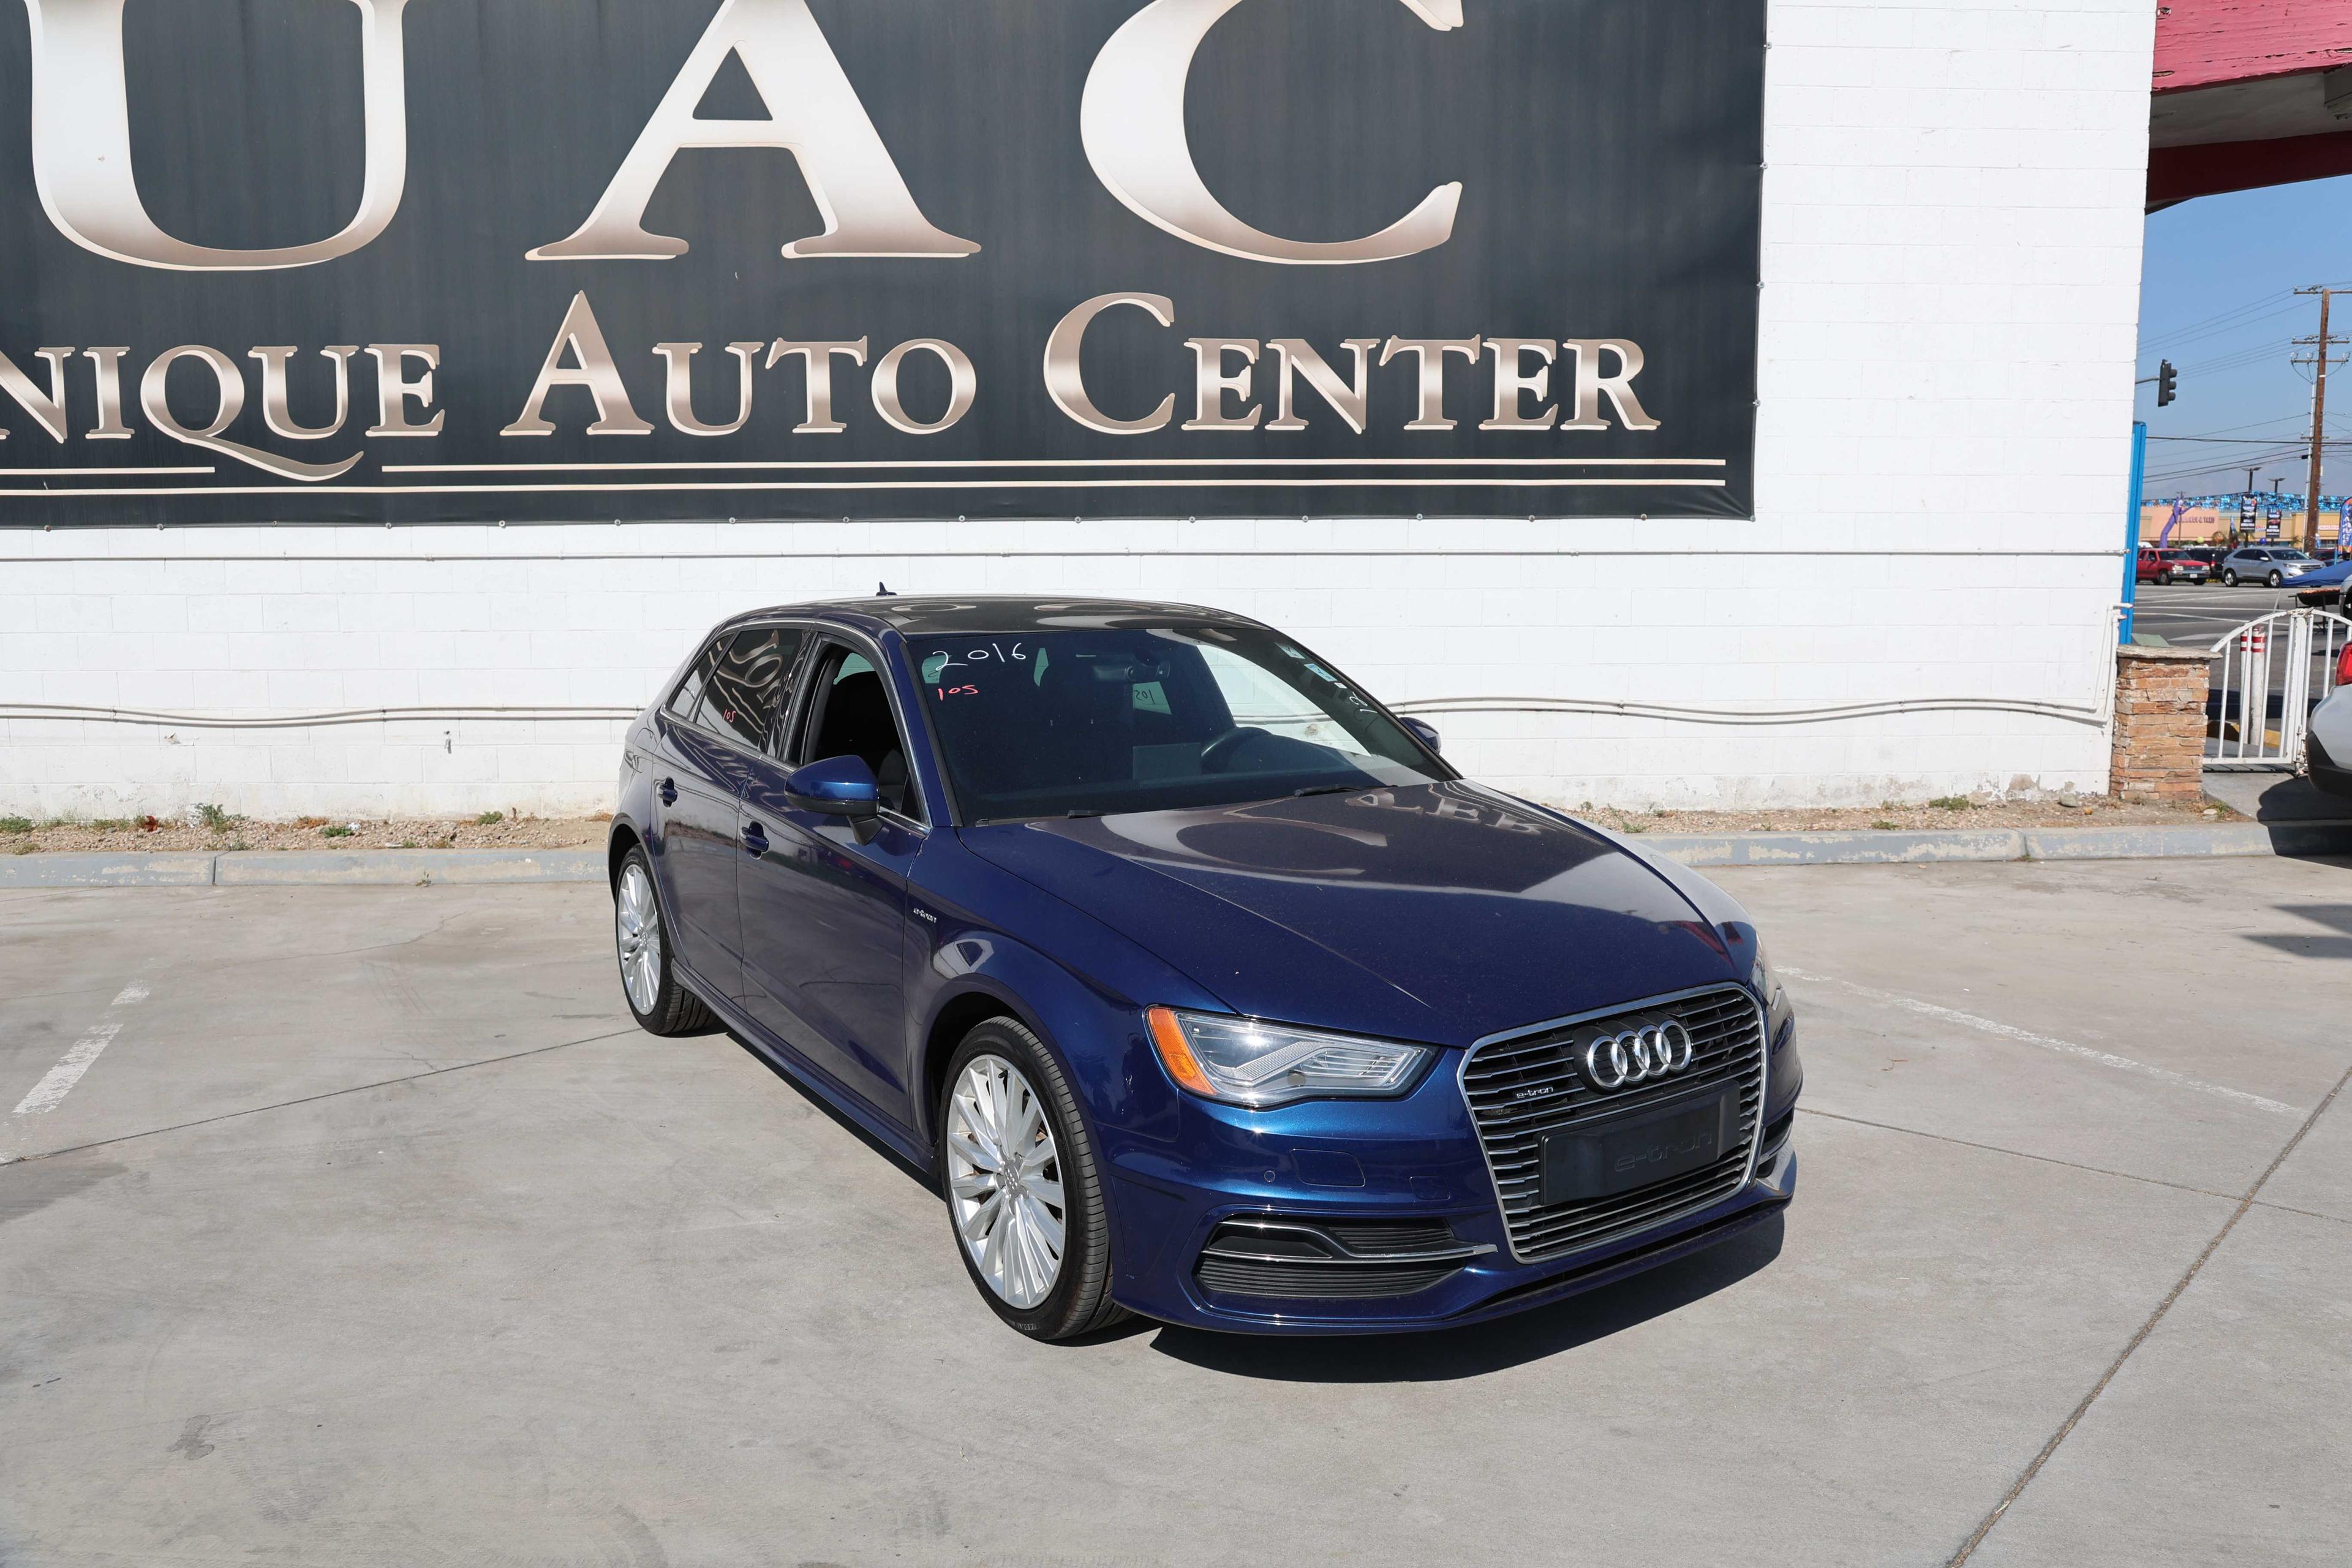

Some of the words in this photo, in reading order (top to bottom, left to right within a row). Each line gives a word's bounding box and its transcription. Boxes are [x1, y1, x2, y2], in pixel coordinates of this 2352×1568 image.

[24, 0, 1464, 271] UAC
[499, 290, 977, 436] AUTO
[1043, 292, 1661, 435] CENTER
[932, 643, 1027, 671] 2016
[938, 685, 979, 701] 105
[722, 709, 736, 723] 105
[1517, 1087, 1554, 1099] e-tron
